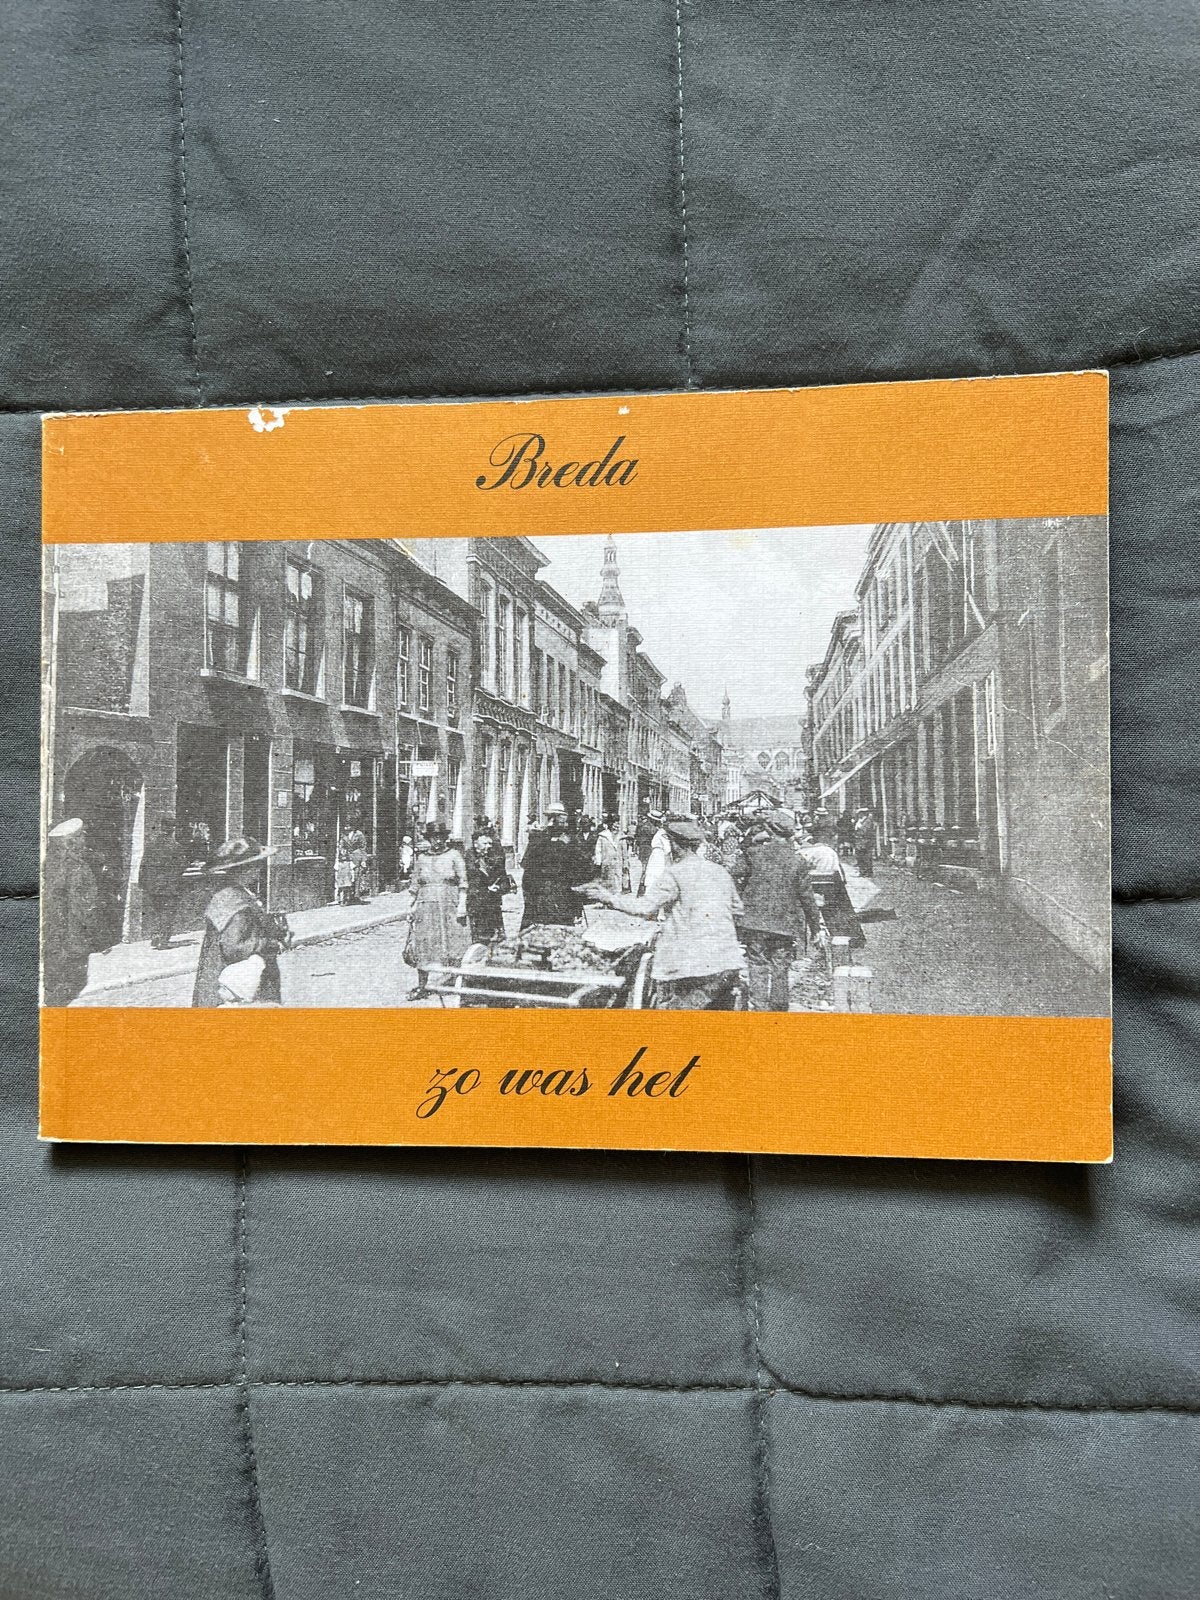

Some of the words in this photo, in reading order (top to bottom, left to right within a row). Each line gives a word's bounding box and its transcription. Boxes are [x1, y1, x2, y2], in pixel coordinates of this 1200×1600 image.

[476, 433, 638, 490] Breda
[415, 1067, 481, 1119] zo
[498, 1067, 592, 1097] was
[608, 1045, 701, 1098] het
